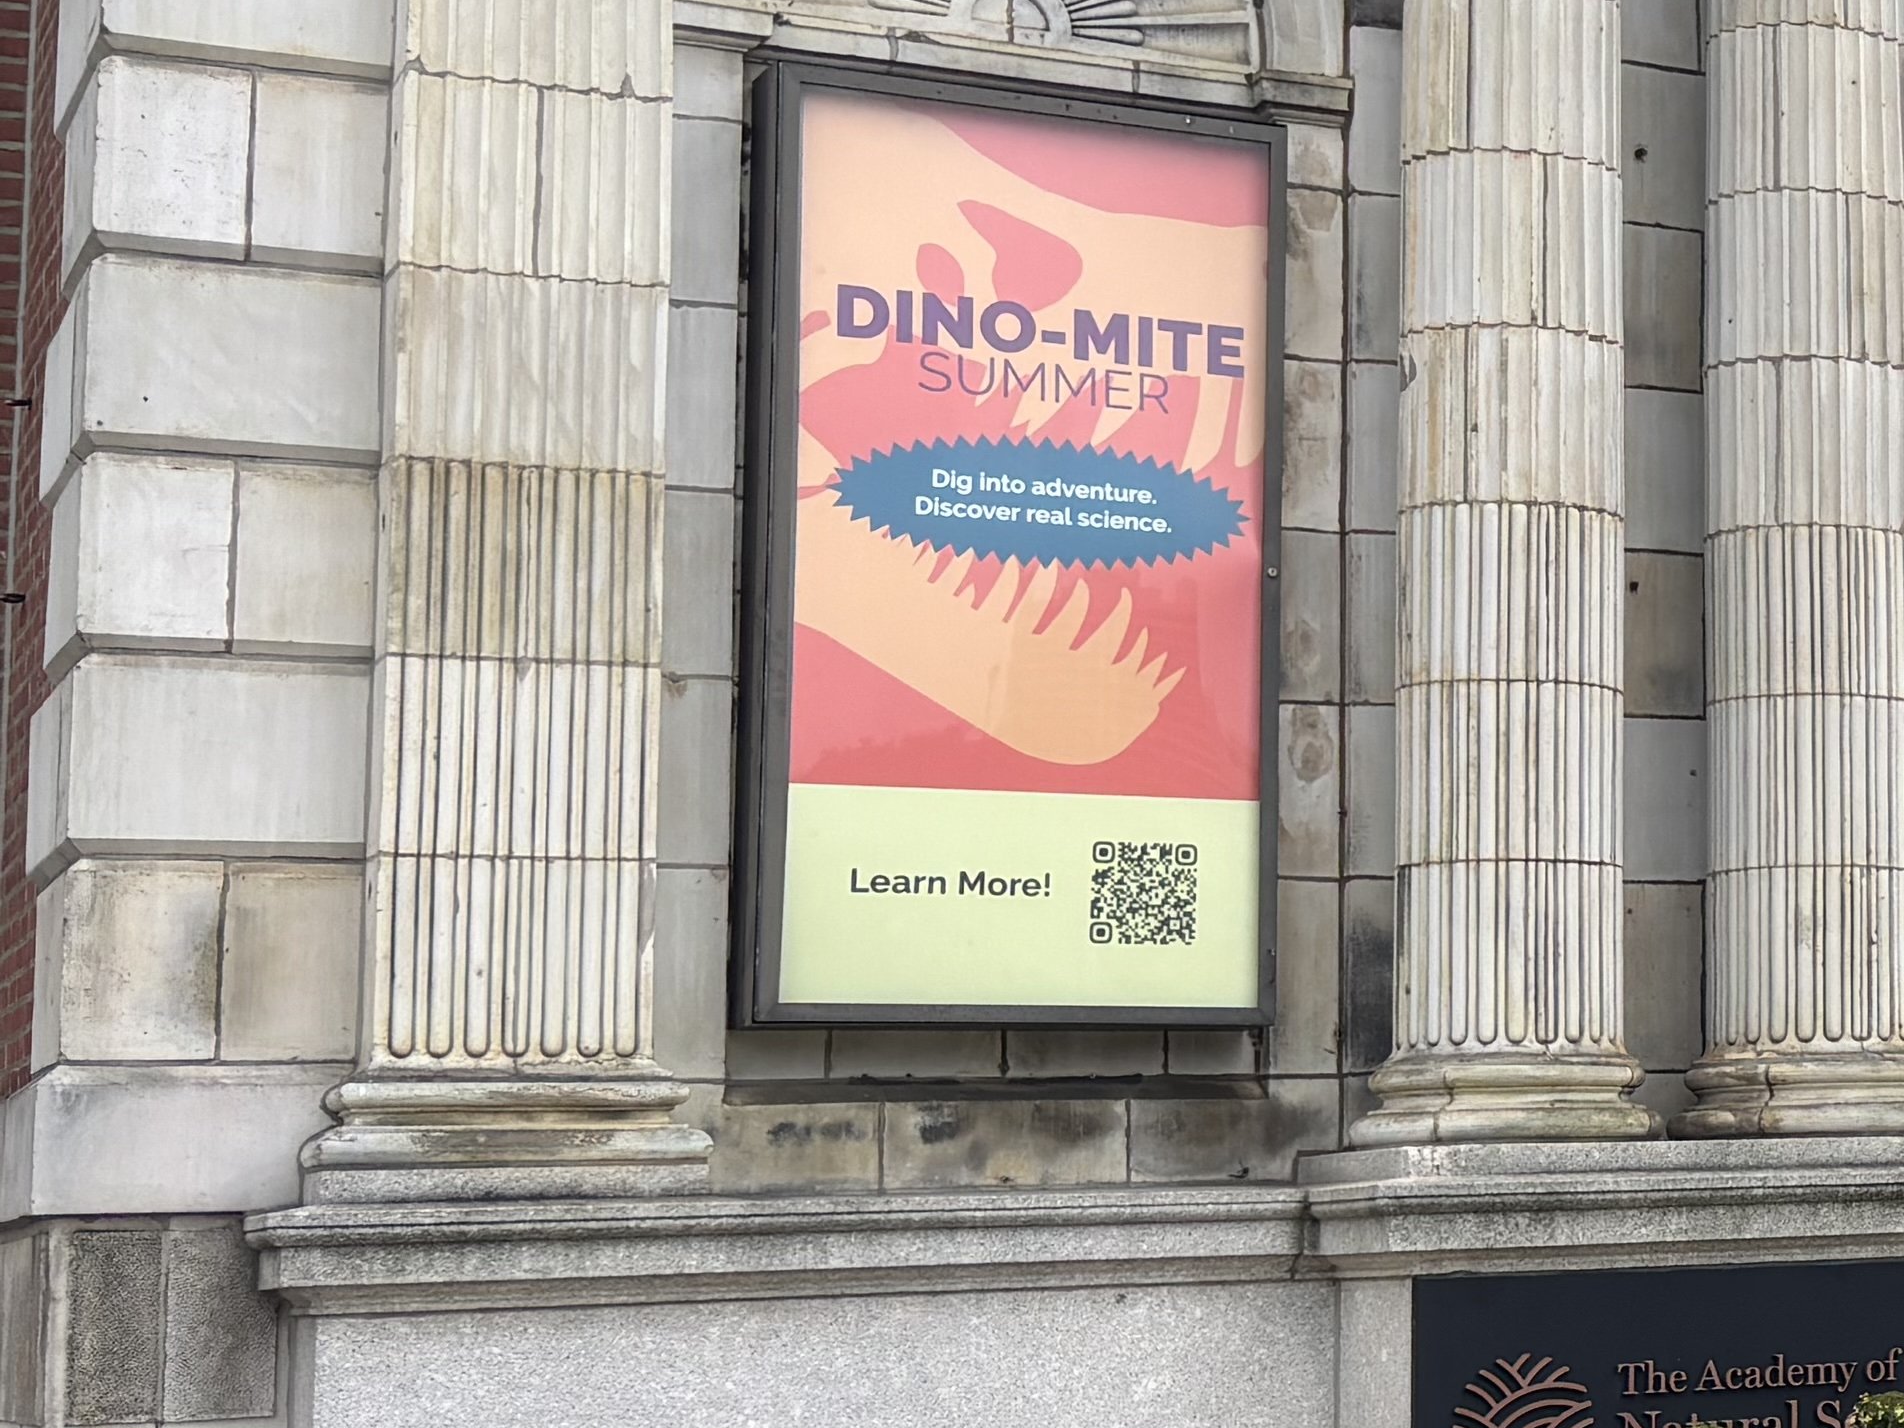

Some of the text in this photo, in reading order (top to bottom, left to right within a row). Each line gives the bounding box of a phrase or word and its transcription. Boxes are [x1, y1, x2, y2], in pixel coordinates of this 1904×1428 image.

[836, 283, 1245, 378] DINO-MITE
[918, 351, 1169, 414] SUMMER
[931, 468, 1158, 505] Dig into adventure.
[915, 496, 1172, 534] Discover real science.
[850, 867, 1050, 897] Learn More!
[1617, 1347, 1903, 1395] The Academy of
